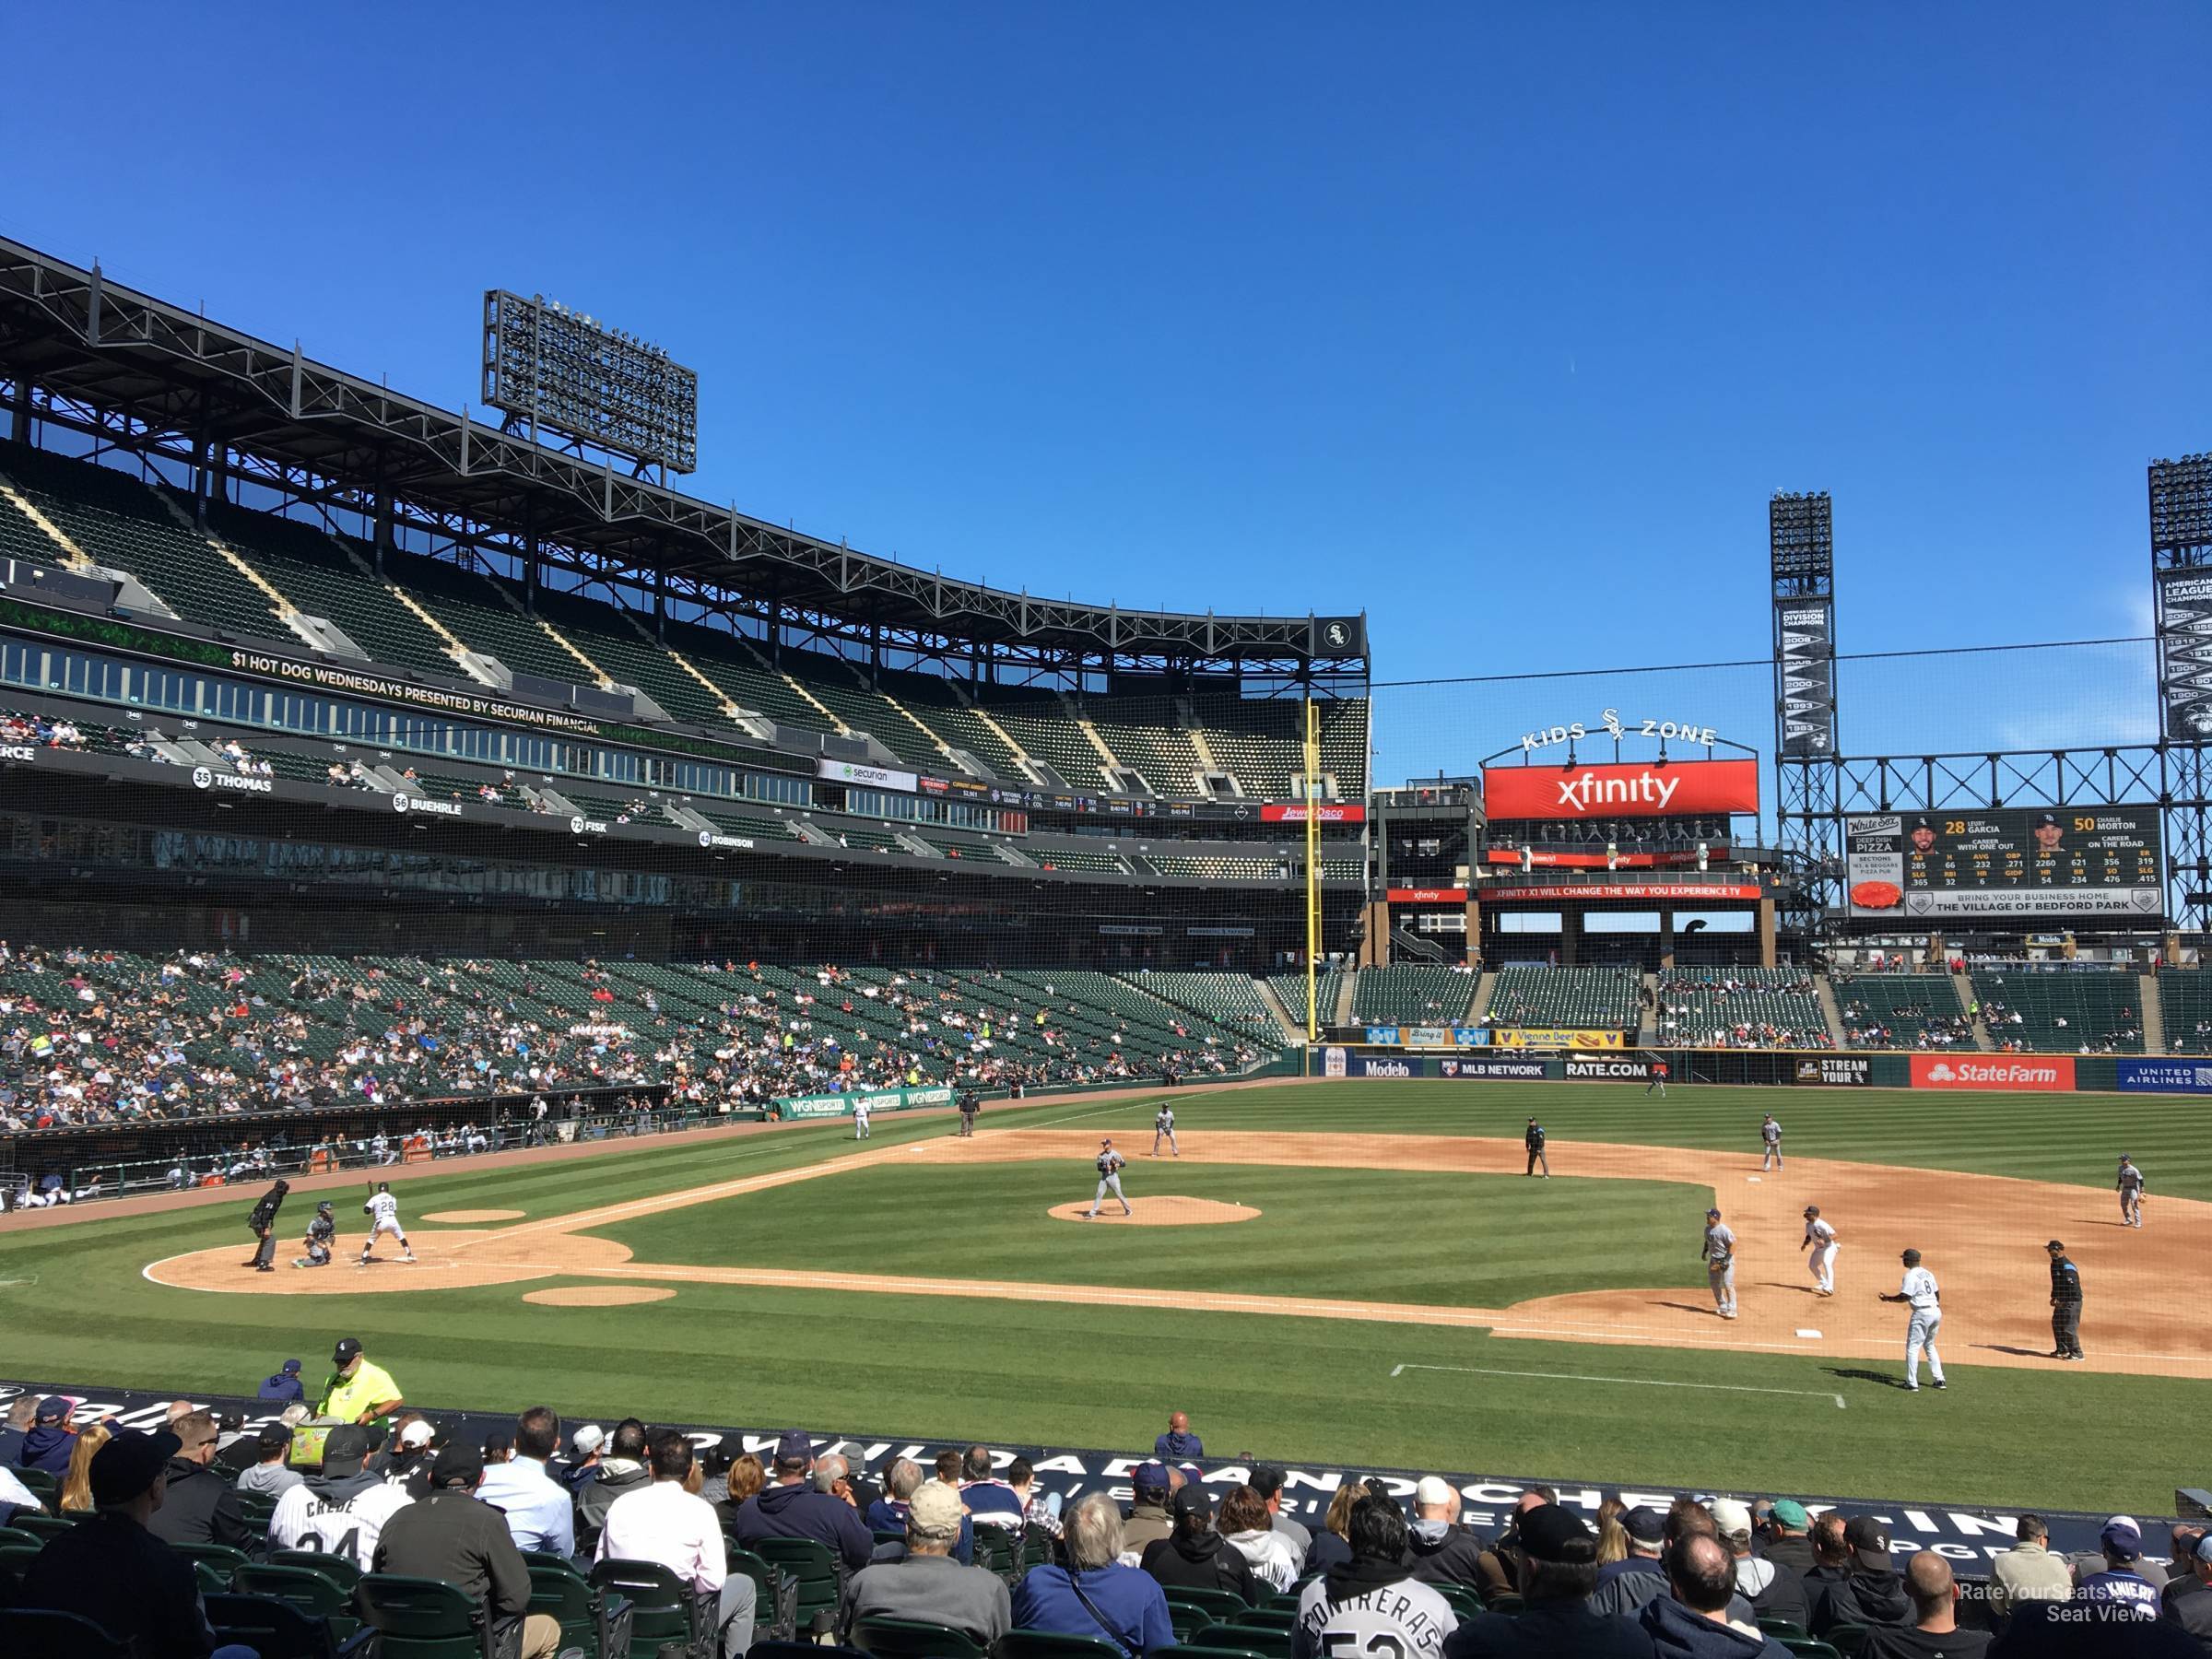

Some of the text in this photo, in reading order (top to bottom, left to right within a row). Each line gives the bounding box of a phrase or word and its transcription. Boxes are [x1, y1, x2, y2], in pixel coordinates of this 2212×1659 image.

[2166, 579, 2212, 589] AMERICAN
[2166, 585, 2212, 597] LEAGUE
[2166, 593, 2212, 604] CHAMPIONS
[1783, 613, 1824, 621] DIVISION
[232, 651, 599, 735] $1 HOT DOG WEDNESDAYS PRESENTED BY SECURIAN FINANCIAL
[1522, 720, 1717, 752] KIDS ZONE
[853, 768, 888, 782] securian
[195, 771, 272, 793] 35 THOMAS
[1558, 771, 1680, 811] xfinity
[394, 797, 462, 816] 56 BUEHRLE
[572, 820, 606, 833] 72 FISK
[1849, 817, 1899, 832] White Sox
[1945, 820, 1966, 835] 28
[2075, 818, 2095, 830] 50
[2097, 822, 2136, 830] MORTON
[1968, 826, 2000, 834] GARCIA
[700, 833, 754, 849] 42 ROBINSON
[1856, 842, 1892, 853] PIZZA
[1945, 861, 1956, 869] 66
[2103, 858, 2120, 866] 356
[1911, 878, 1928, 887] .365
[2041, 877, 2052, 885] 54
[2137, 875, 2156, 883] .415
[1414, 890, 1440, 900] xfinity
[1497, 887, 1741, 898] XFINITY X1 WILL CHANGE THE WAY YOU EXPERIENCE TV
[1958, 893, 1990, 901] BRING
[1993, 893, 2021, 901] YOUR
[2024, 892, 2075, 900] BUSINESS
[1936, 903, 1959, 912] THE
[1962, 902, 2012, 911] VILLAGE
[2035, 901, 2091, 911] BEDFORD
[2096, 900, 2129, 909] PARK
[1411, 1029, 1434, 1040] Bring
[1517, 1030, 1575, 1041] Vienna Beef
[1365, 1061, 1409, 1077] Modelo
[1462, 1065, 1542, 1076] MLB NETWORK
[1567, 1063, 1648, 1077] RATE.COM
[1821, 1059, 1868, 1071] STREAM
[1821, 1071, 1852, 1083] YOUR
[2139, 1068, 2192, 1077] UNITED
[2127, 1077, 2192, 1085] AIRLINES
[877, 1097, 900, 1106] SPORTS
[907, 1091, 950, 1105] WGN SPORTS
[789, 1100, 844, 1112] WGN SPORTS
[381, 1201, 394, 1212] 28
[1924, 1280, 1932, 1294] 8
